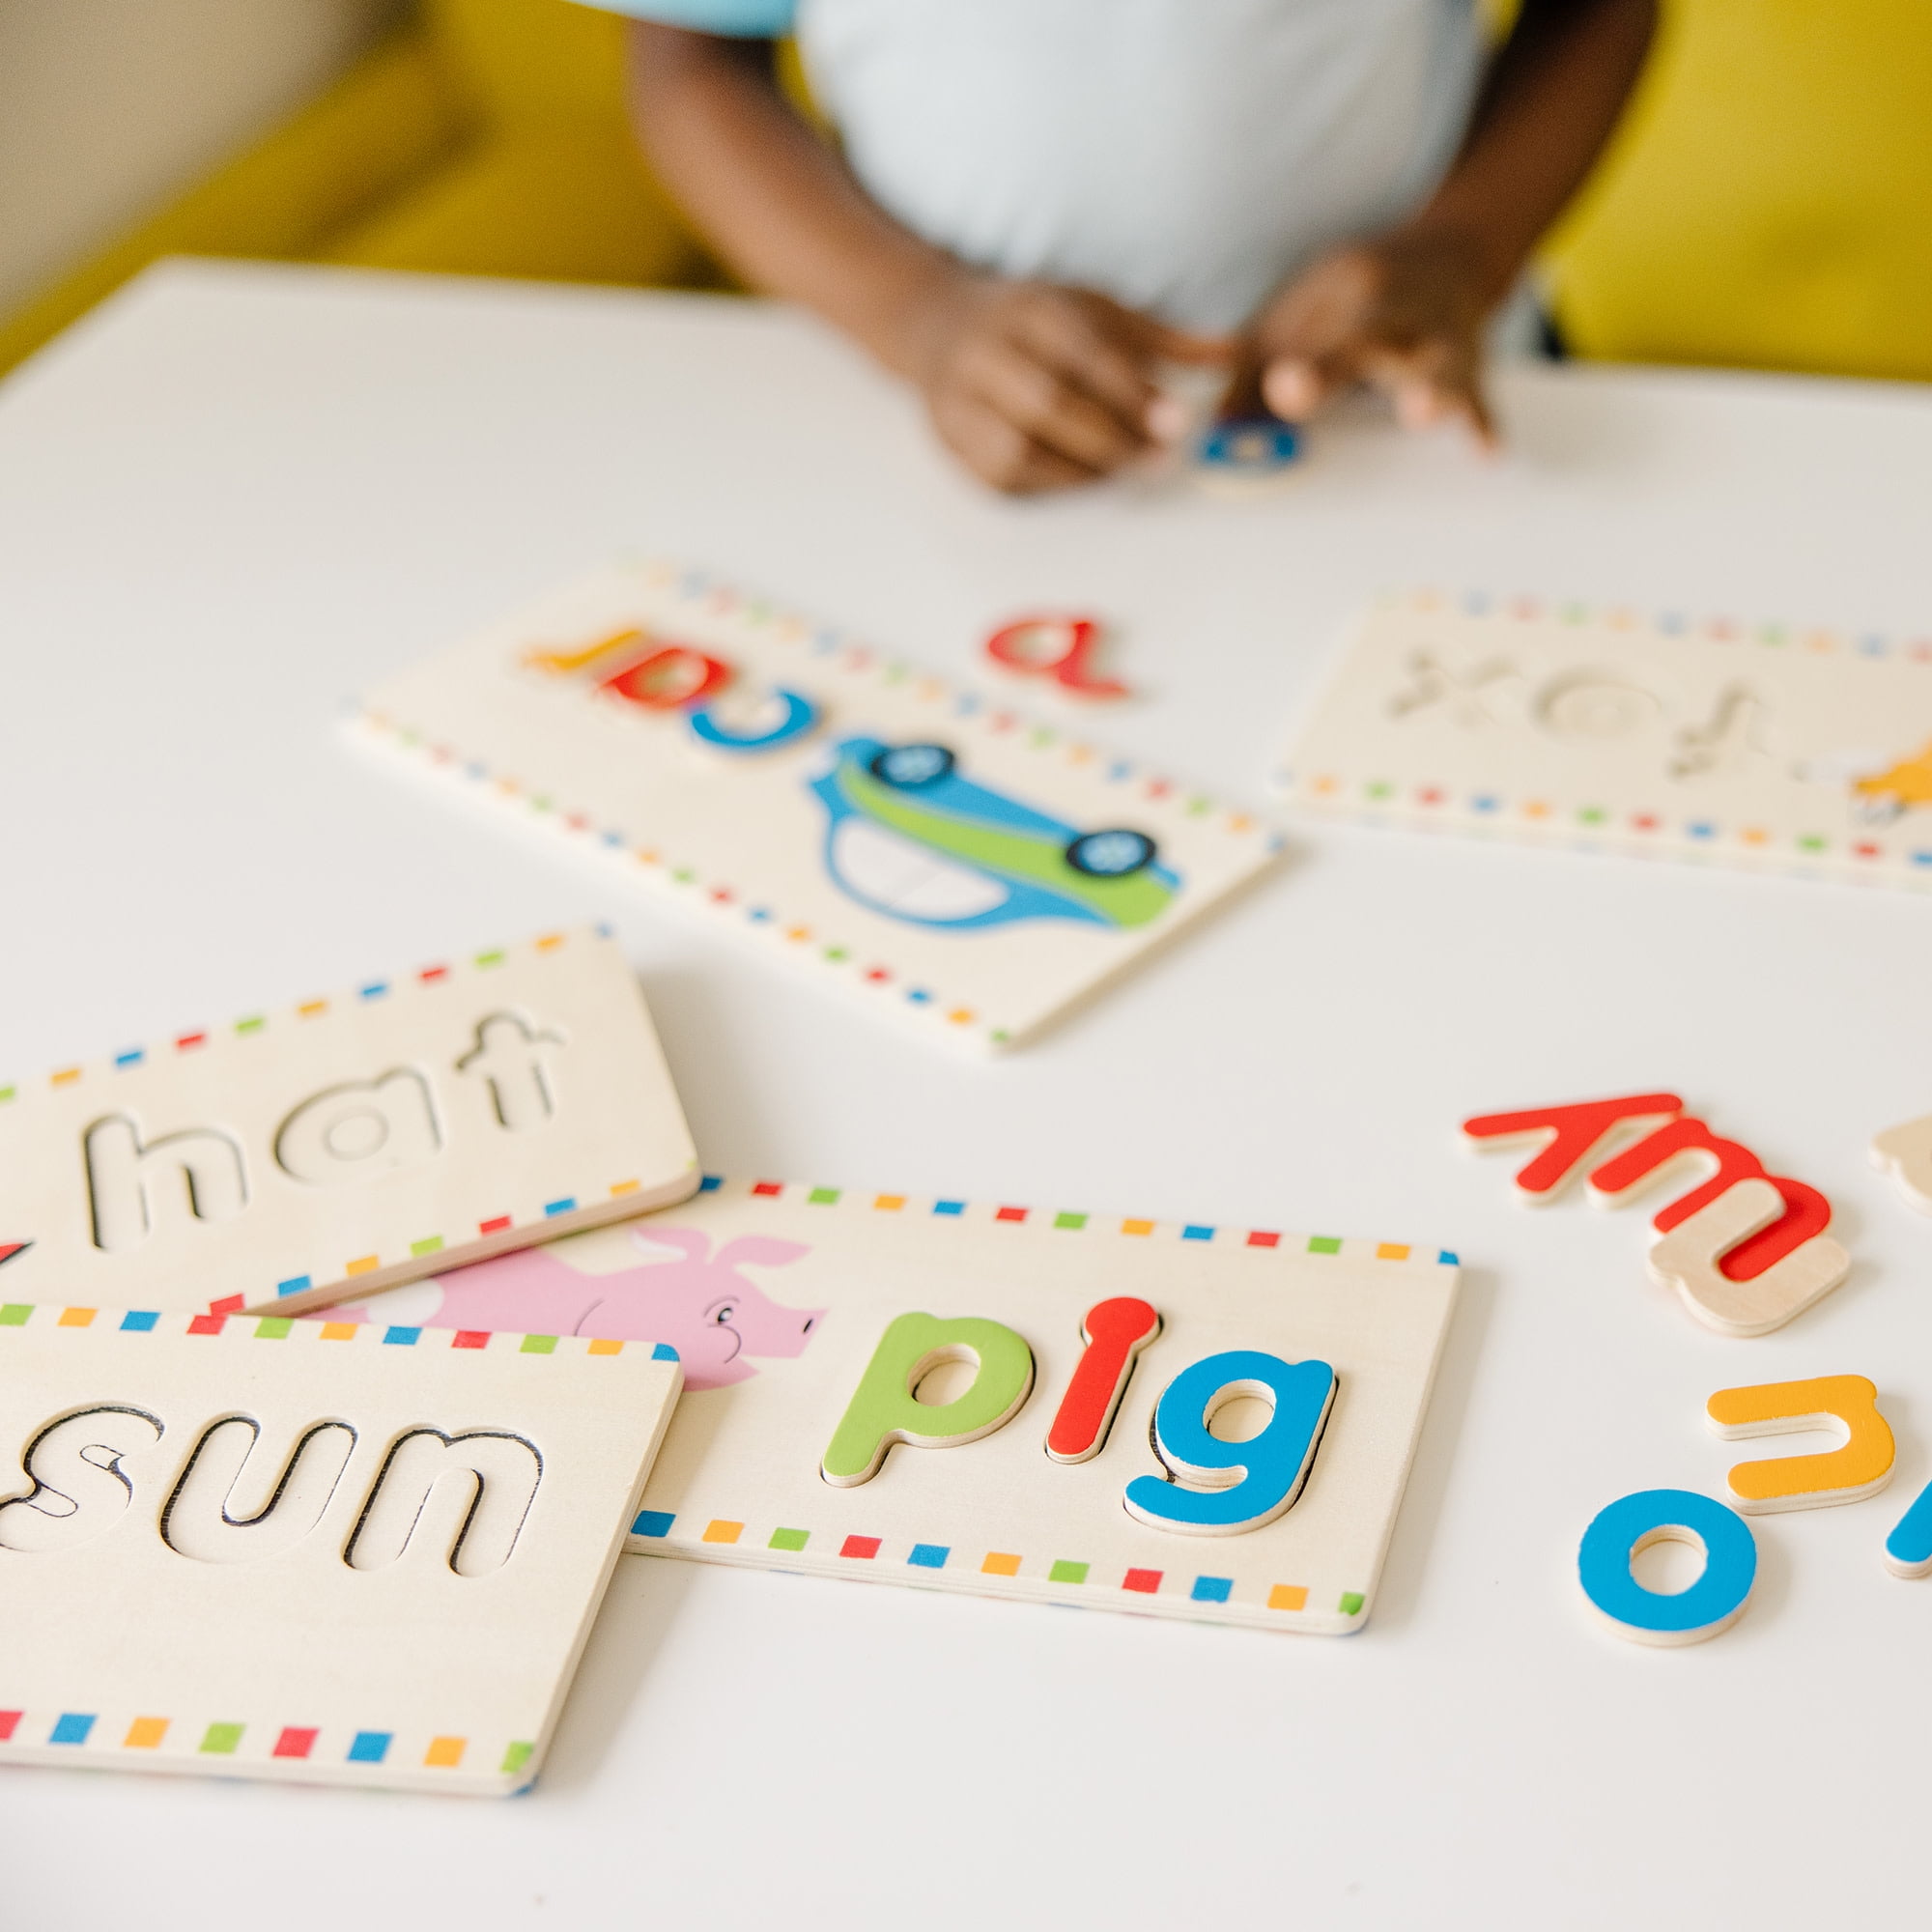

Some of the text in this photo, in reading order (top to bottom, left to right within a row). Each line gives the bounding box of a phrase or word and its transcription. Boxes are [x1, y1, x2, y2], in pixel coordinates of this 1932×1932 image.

[520, 623, 821, 756] car
[983, 614, 1136, 701] a
[83, 1009, 566, 1254] hat
[0, 1401, 544, 1578] sun
[821, 1296, 1341, 1536] pig
